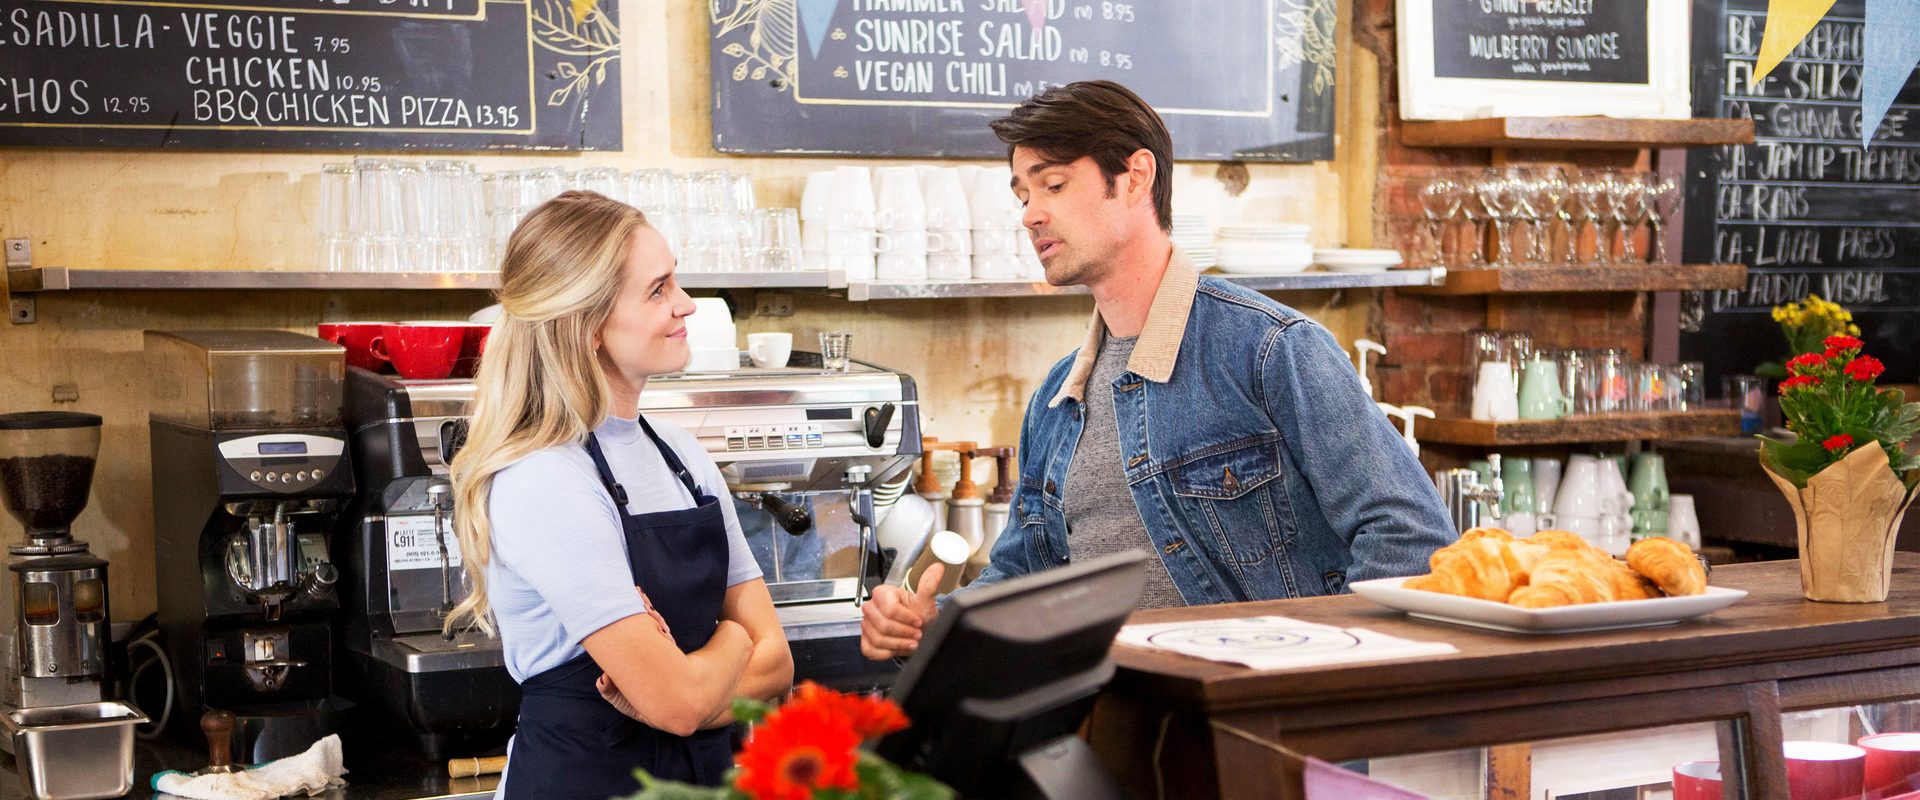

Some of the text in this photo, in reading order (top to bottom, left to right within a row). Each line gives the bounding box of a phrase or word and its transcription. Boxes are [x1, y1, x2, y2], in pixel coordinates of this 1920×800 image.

[1101, 1, 1135, 22] 8.95
[181, 13, 298, 53] VEGGIE
[313, 36, 350, 54] 7.95
[854, 18, 966, 56] SUNRISE
[978, 20, 1062, 62] SALAD
[1099, 49, 1133, 70] 8.95
[1469, 31, 1621, 60] MULBERRY SUNRISE
[185, 56, 381, 92] CHICKEN 10.95
[855, 60, 934, 93] VEGAN
[945, 61, 1006, 97] CHILI
[1784, 62, 1864, 101] SILKY
[103, 96, 150, 113] 12.95
[194, 89, 519, 128] BBQ CHICKEN PIZZA 13.95
[1771, 103, 1847, 141] GUAVA
[1822, 271, 1890, 303] VISUAL
